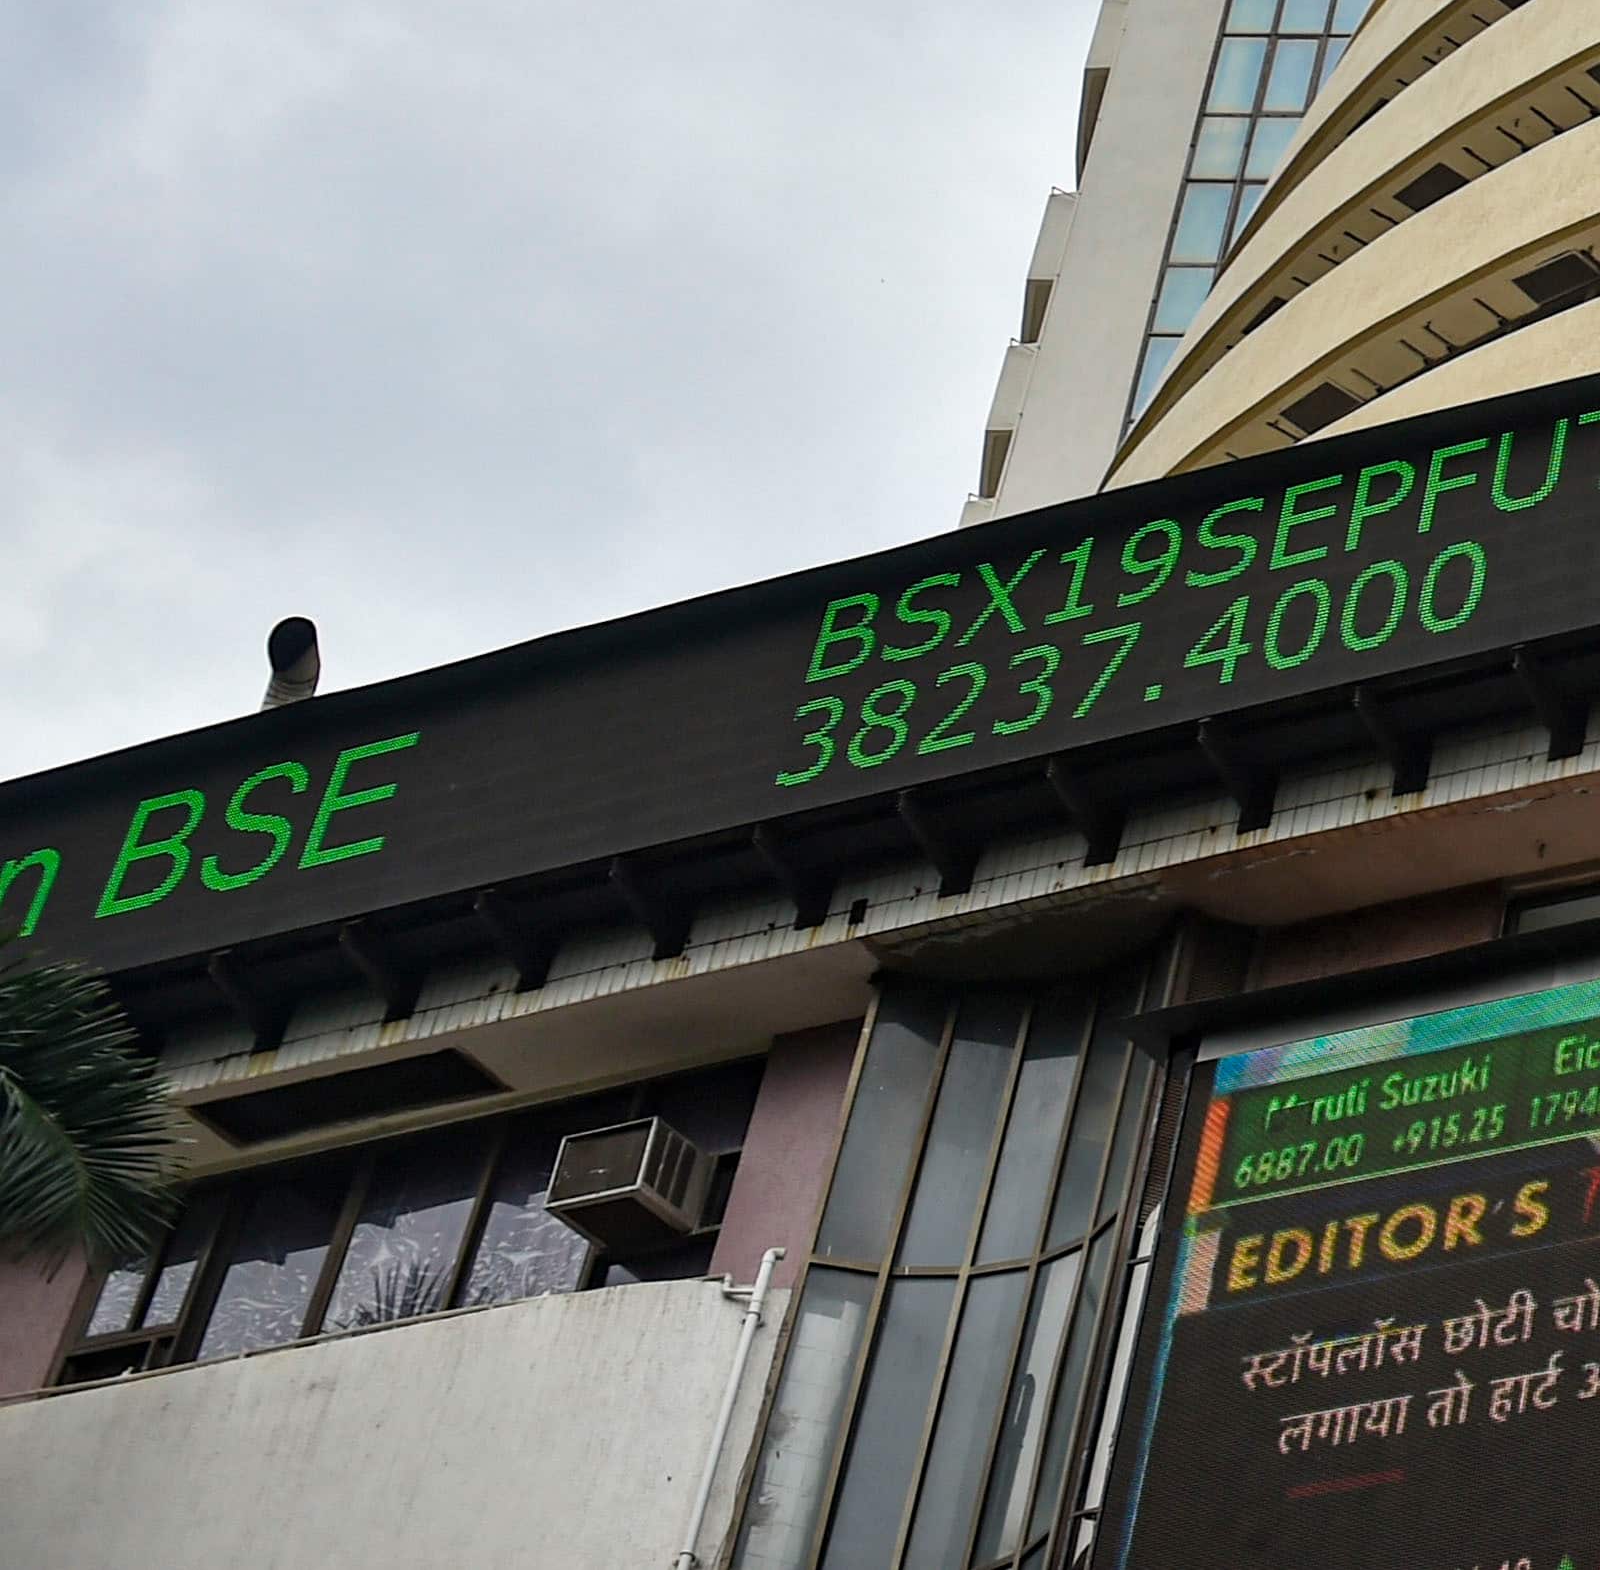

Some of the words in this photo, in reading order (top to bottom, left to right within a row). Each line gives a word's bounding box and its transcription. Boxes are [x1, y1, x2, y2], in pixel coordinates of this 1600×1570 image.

[776, 541, 1489, 787] 38237.4000
[94, 733, 420, 918] BSE
[1264, 1077, 1372, 1130] ruti
[1378, 1053, 1493, 1111] Suzuki
[1233, 1132, 1366, 1189] 6887.00
[1392, 1103, 1507, 1155] +915.25
[1227, 1180, 1551, 1292] EDITOR'S
[1442, 1288, 1537, 1356] छोटी
[1278, 1394, 1414, 1455] लगाया
[1426, 1368, 1476, 1429] तो
[1489, 1349, 1565, 1423] हार्ट
